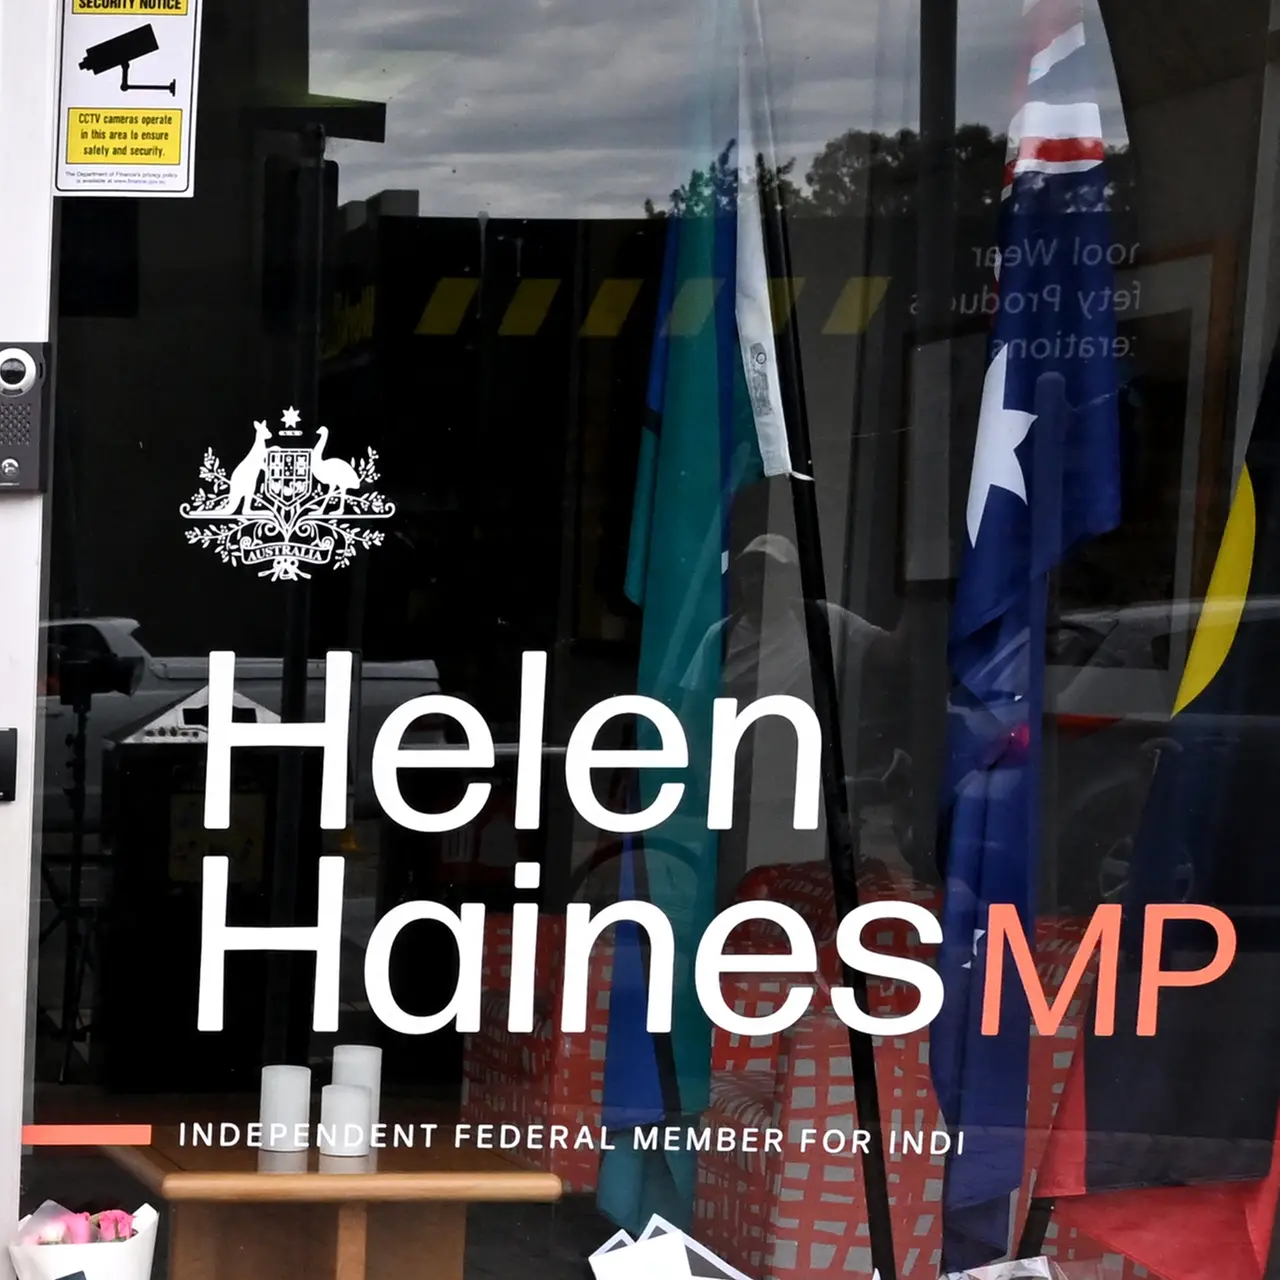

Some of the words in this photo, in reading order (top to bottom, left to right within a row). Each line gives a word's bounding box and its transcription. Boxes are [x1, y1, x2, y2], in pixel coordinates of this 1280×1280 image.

[78, 0, 135, 9] SECURITY
[140, 0, 181, 10] NOTICE
[78, 113, 100, 124] CCTV
[103, 115, 138, 124] cameras
[141, 114, 172, 126] operate
[81, 129, 88, 139] in
[91, 130, 106, 139] this
[109, 131, 127, 140] area
[131, 130, 138, 140] to
[141, 131, 169, 140] ensure
[83, 146, 109, 157] safety
[112, 146, 127, 156] and
[130, 146, 165, 158] security.
[247, 545, 322, 561] AUSTRALIA
[203, 650, 823, 832] Helen
[196, 856, 944, 1036] Haines
[981, 903, 1237, 1037] MP
[179, 1122, 437, 1148] INDEPENDENT
[454, 1124, 614, 1149] FEDERAL
[633, 1126, 783, 1152] MEMBER
[800, 1129, 871, 1153] FOR
[889, 1131, 964, 1154] INDI
